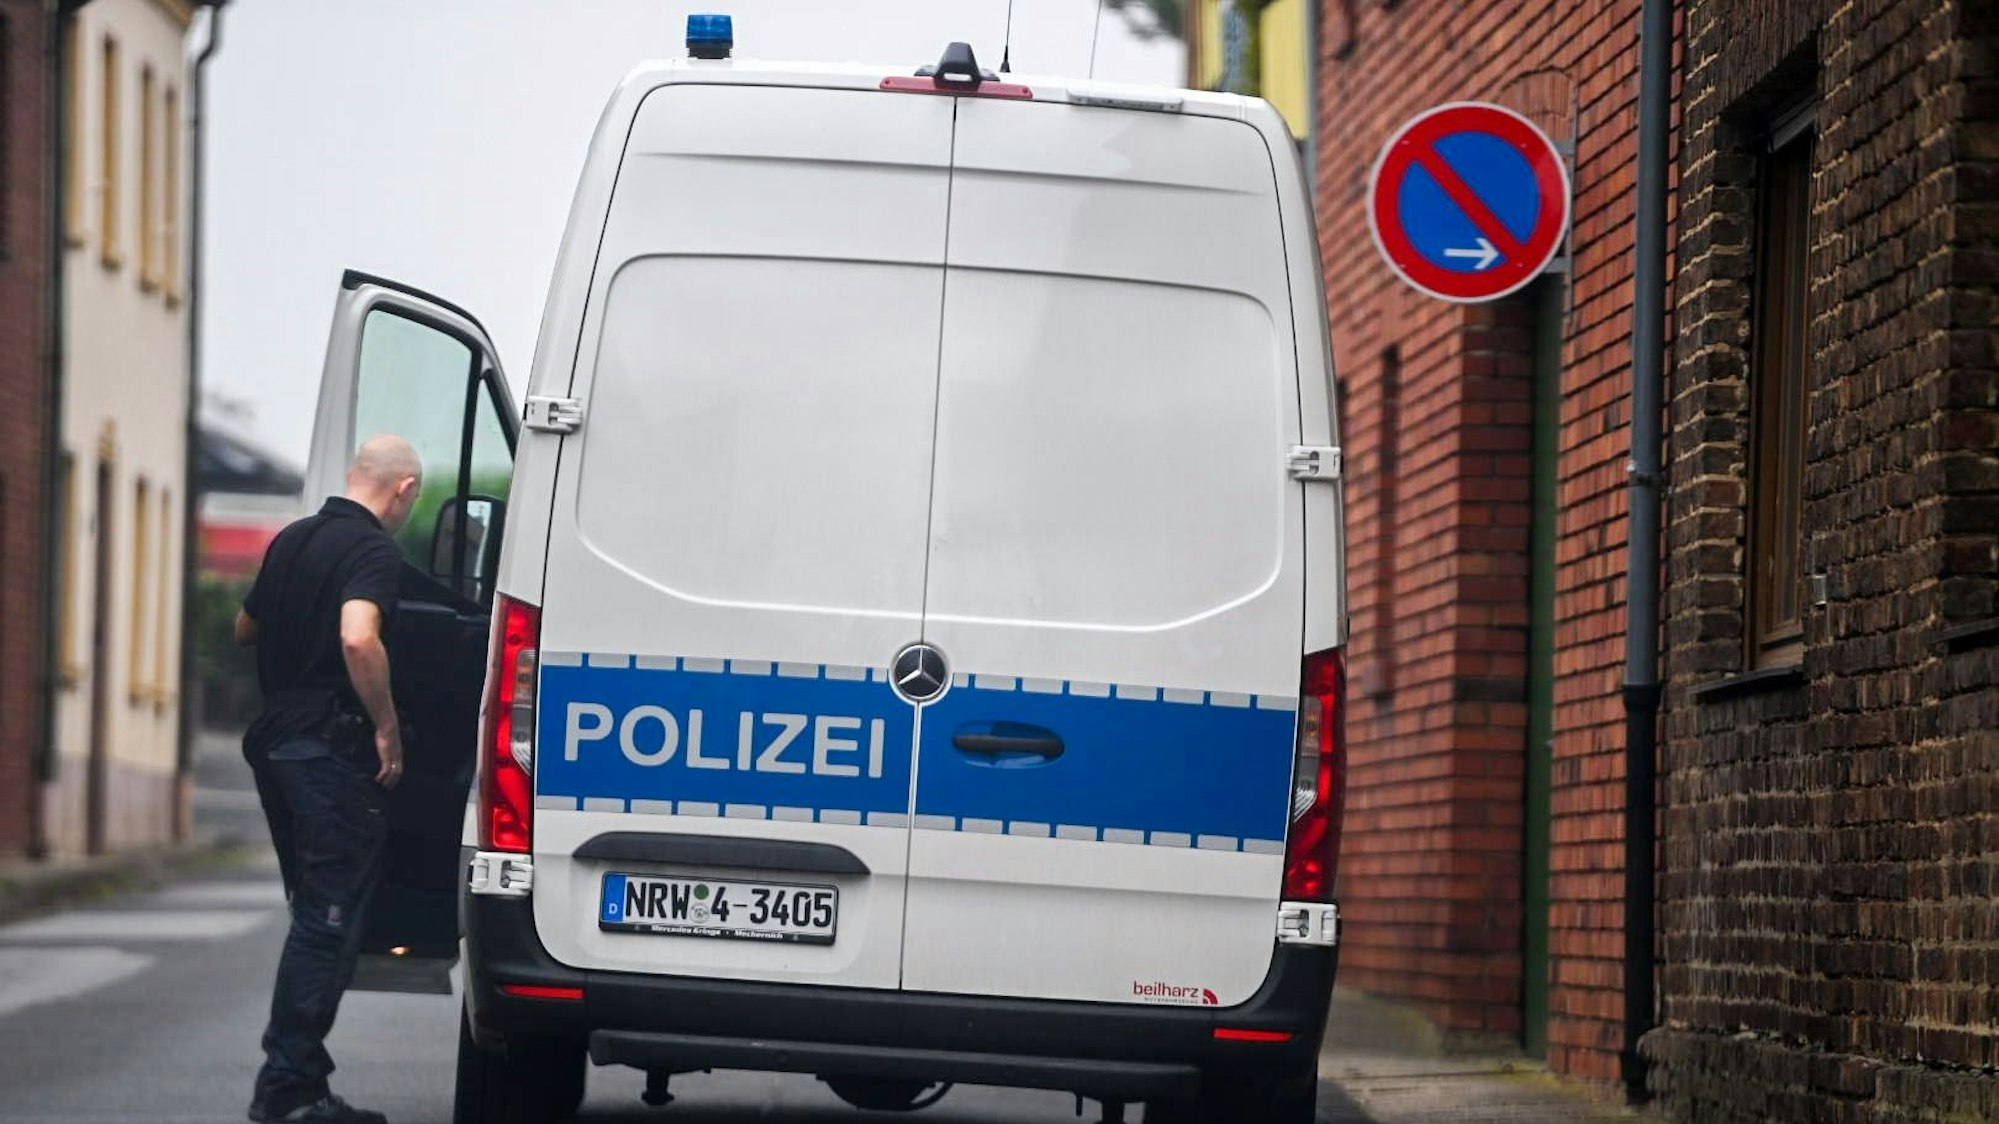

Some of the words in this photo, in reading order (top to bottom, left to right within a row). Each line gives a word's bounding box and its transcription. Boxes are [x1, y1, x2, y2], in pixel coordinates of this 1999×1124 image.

[564, 701, 885, 778] POLIZEI
[608, 903, 618, 914] D
[626, 881, 690, 919] NRW
[711, 886, 832, 928] 4-3405
[734, 929, 783, 939] Mechernich
[1133, 981, 1199, 998] beilharz
